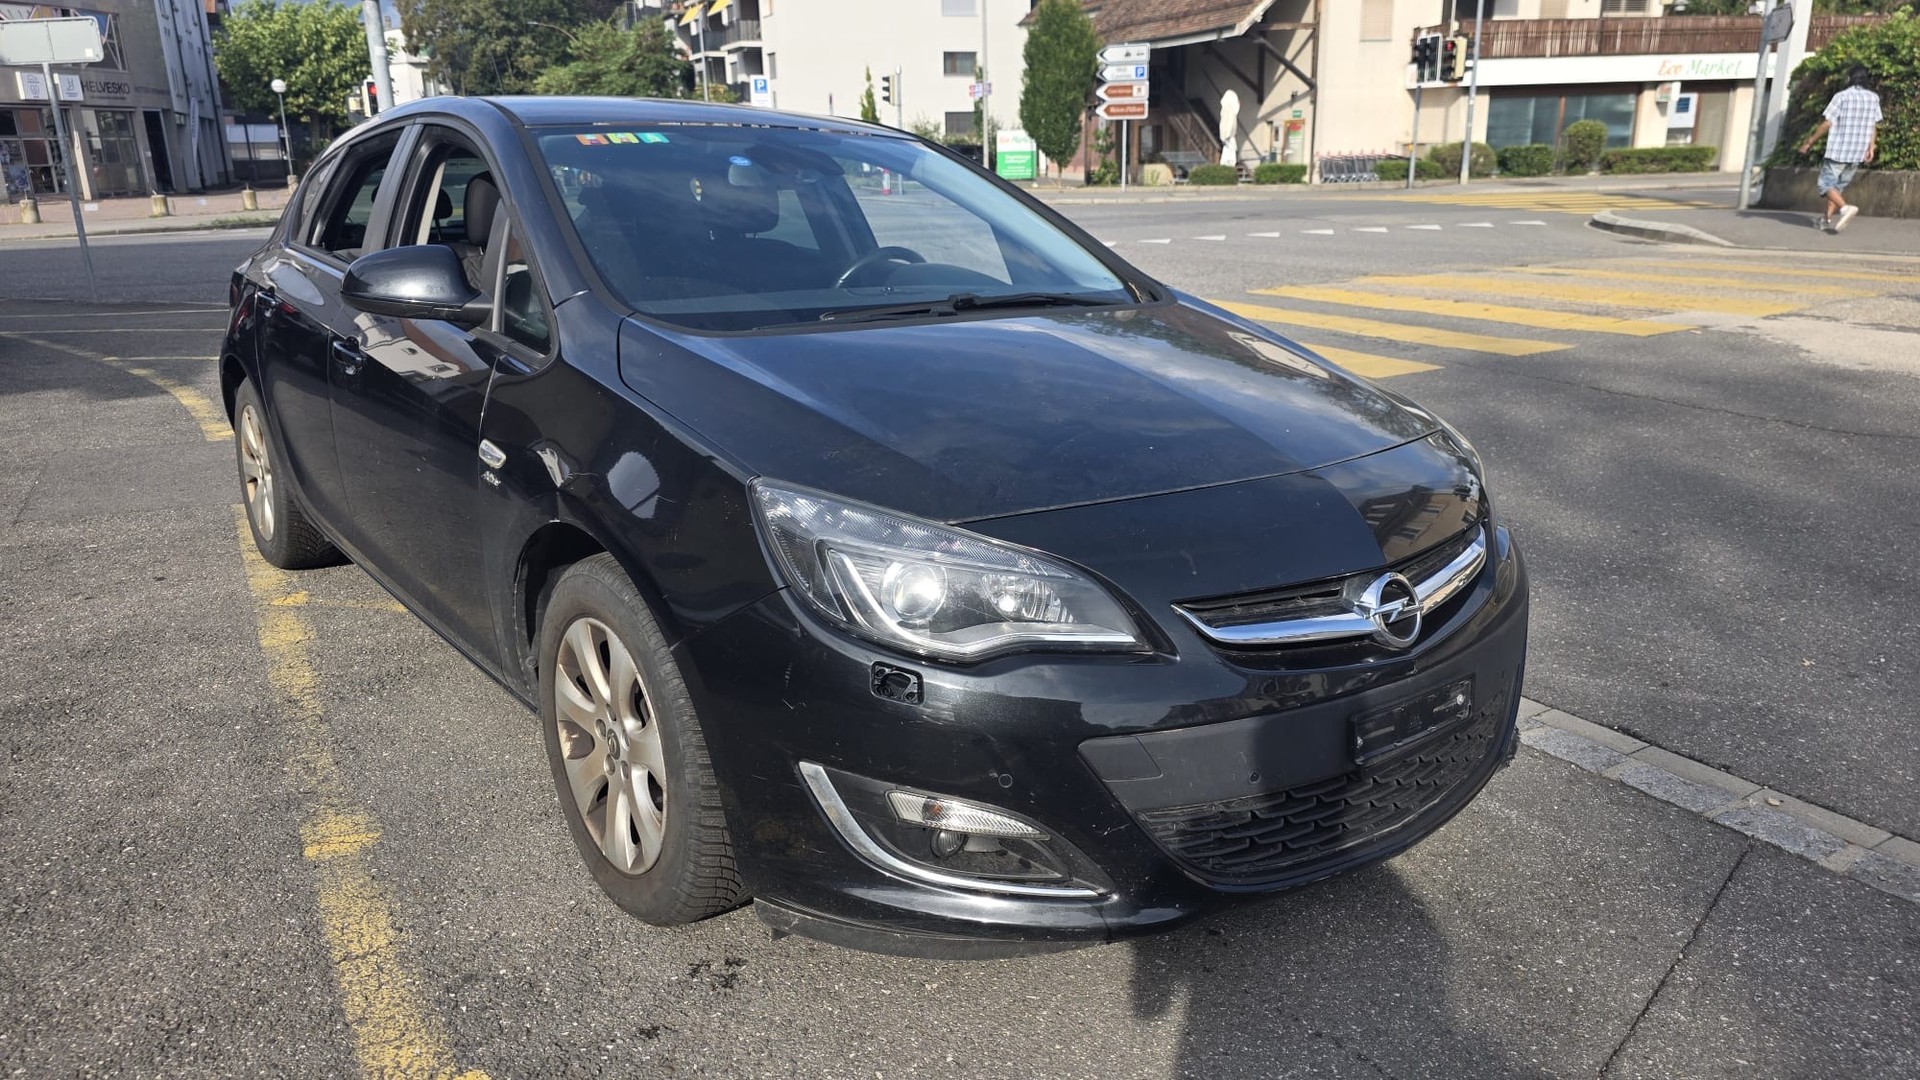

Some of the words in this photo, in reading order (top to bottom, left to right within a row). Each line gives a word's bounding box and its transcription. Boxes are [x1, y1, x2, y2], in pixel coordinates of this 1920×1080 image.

[1658, 60, 1682, 76] Eco
[1686, 59, 1743, 76] Market
[82, 80, 130, 94] HELVESKO
